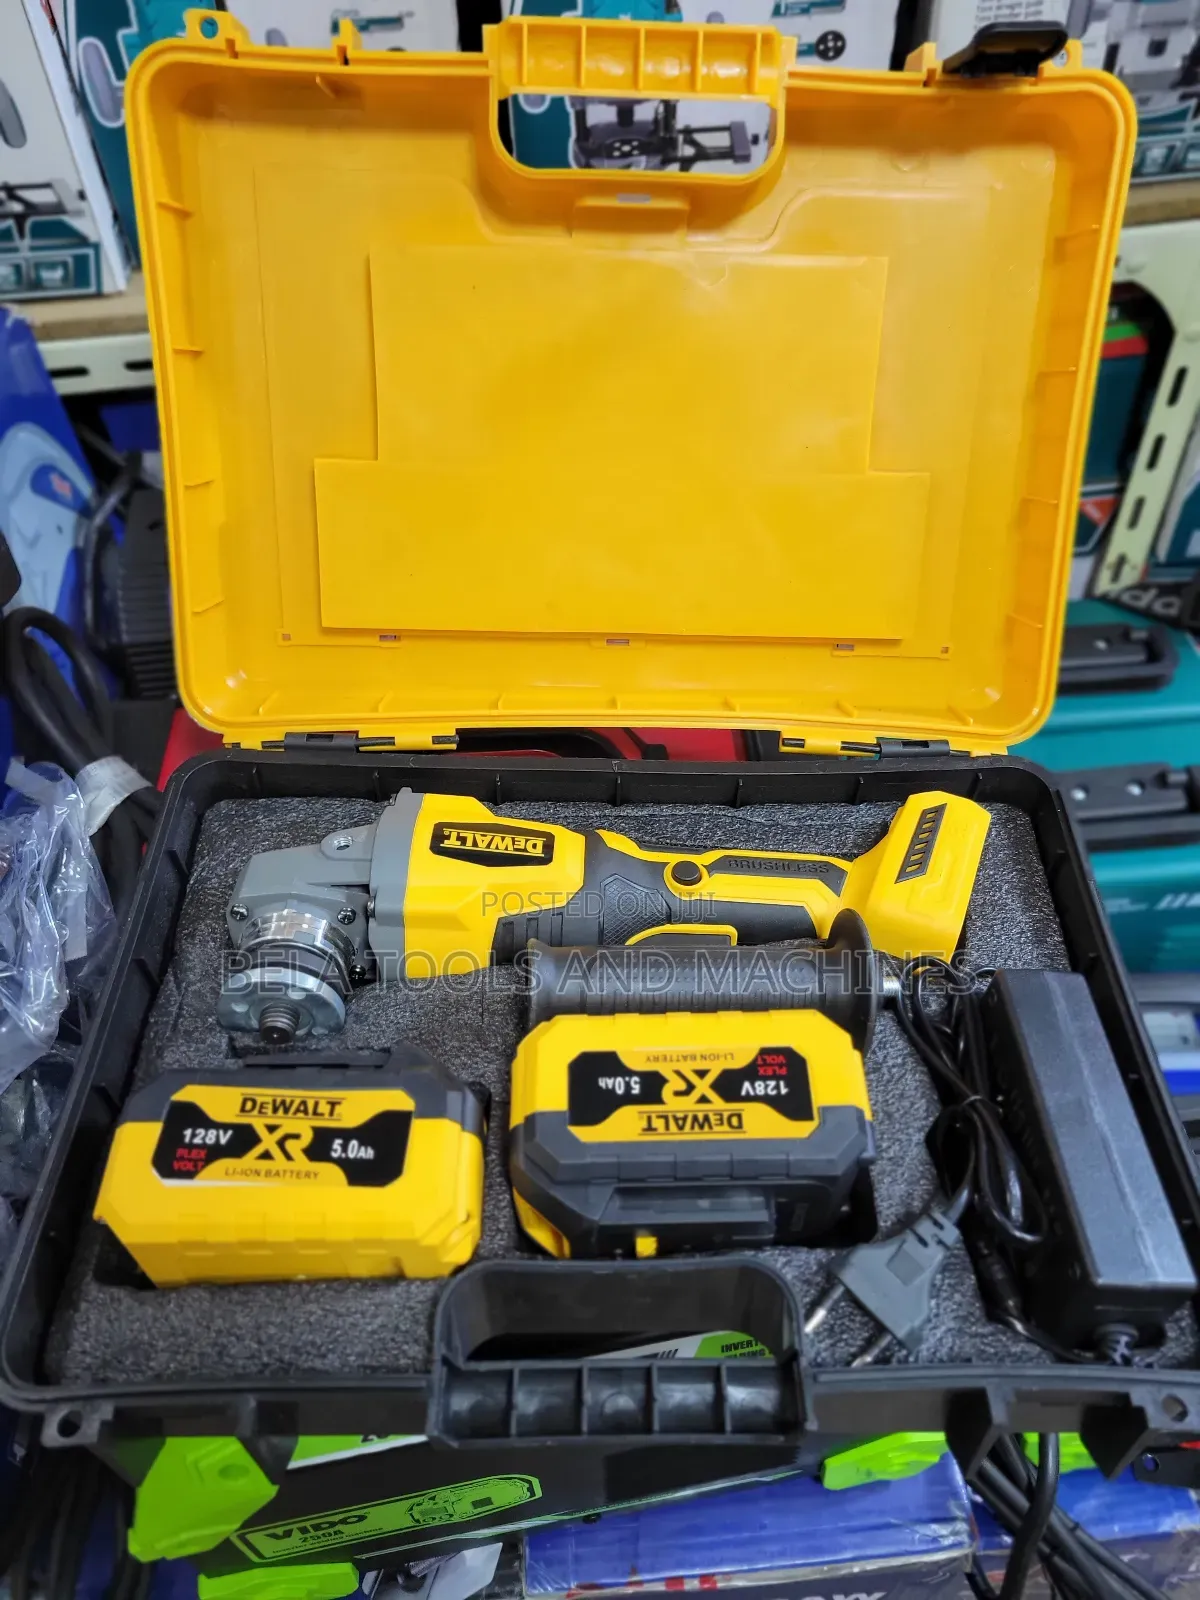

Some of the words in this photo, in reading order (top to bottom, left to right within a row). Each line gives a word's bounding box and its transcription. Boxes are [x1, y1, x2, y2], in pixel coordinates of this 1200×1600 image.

[727, 859, 830, 873] BRUSHLESS
[645, 1053, 699, 1064] BATTERY
[701, 1052, 735, 1063] LI-ION
[756, 1053, 787, 1065] VOLT
[598, 1076, 641, 1096] 5.0Ah
[660, 1068, 727, 1104] XR
[740, 1080, 790, 1096] 128V
[182, 1128, 234, 1146] 128V
[241, 1122, 314, 1162] XR
[330, 1138, 375, 1160] 5.0Ah
[172, 1160, 204, 1171] VOLT
[224, 1167, 262, 1178] LI-ION
[264, 1168, 320, 1180] BATTERY
[264, 1514, 369, 1541] VIDO
